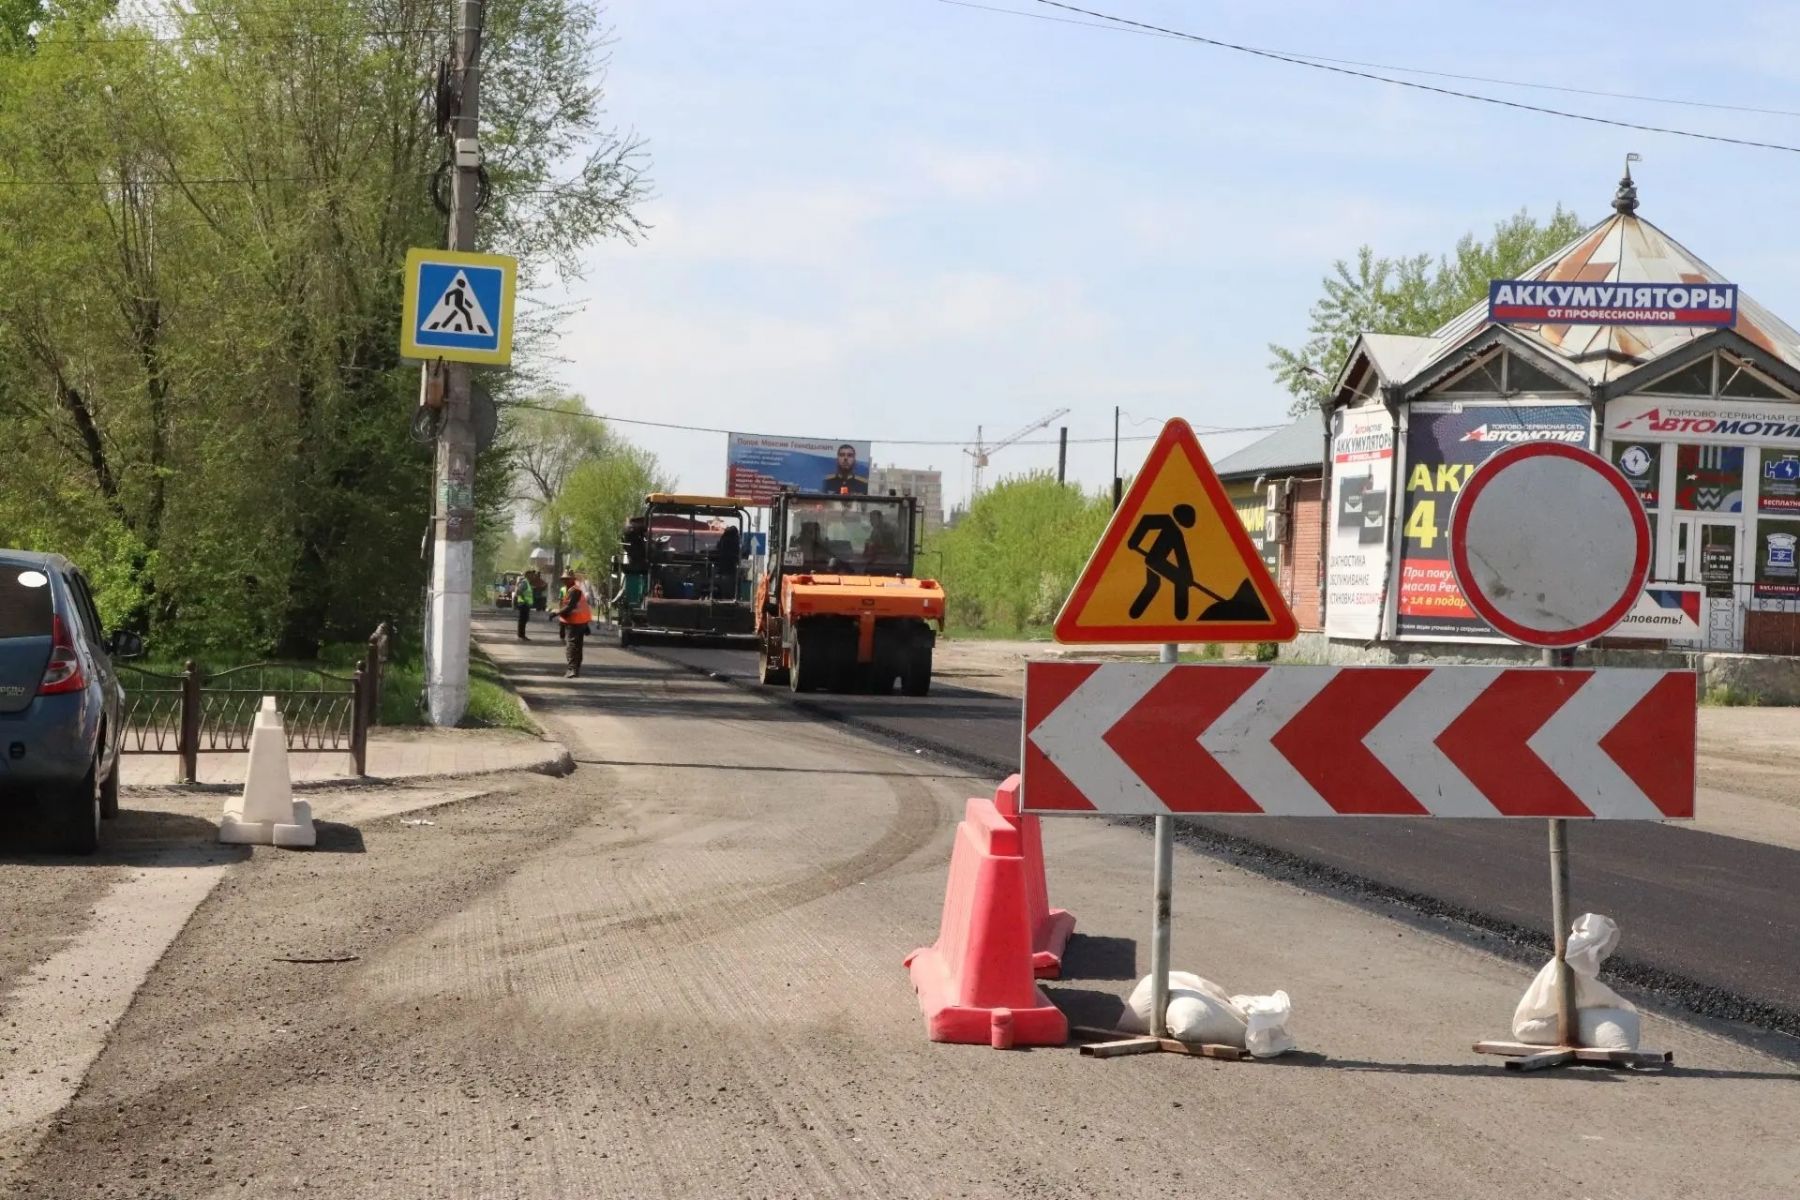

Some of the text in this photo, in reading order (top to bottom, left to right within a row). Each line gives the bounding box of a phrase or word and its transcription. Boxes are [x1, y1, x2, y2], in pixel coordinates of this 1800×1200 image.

[1495, 285, 1732, 309] АККУМУЛЯТОРЫ
[1547, 309, 1676, 321] ОТ ПРОФЕССИОНАЛОВ
[1459, 423, 1586, 442] АВТОМОТИВ
[1404, 500, 1438, 548] 4
[1403, 567, 1425, 581] При
[1402, 583, 1436, 593] масла
[1330, 593, 1354, 605] СТАНОВКА
[1426, 597, 1433, 605] в
